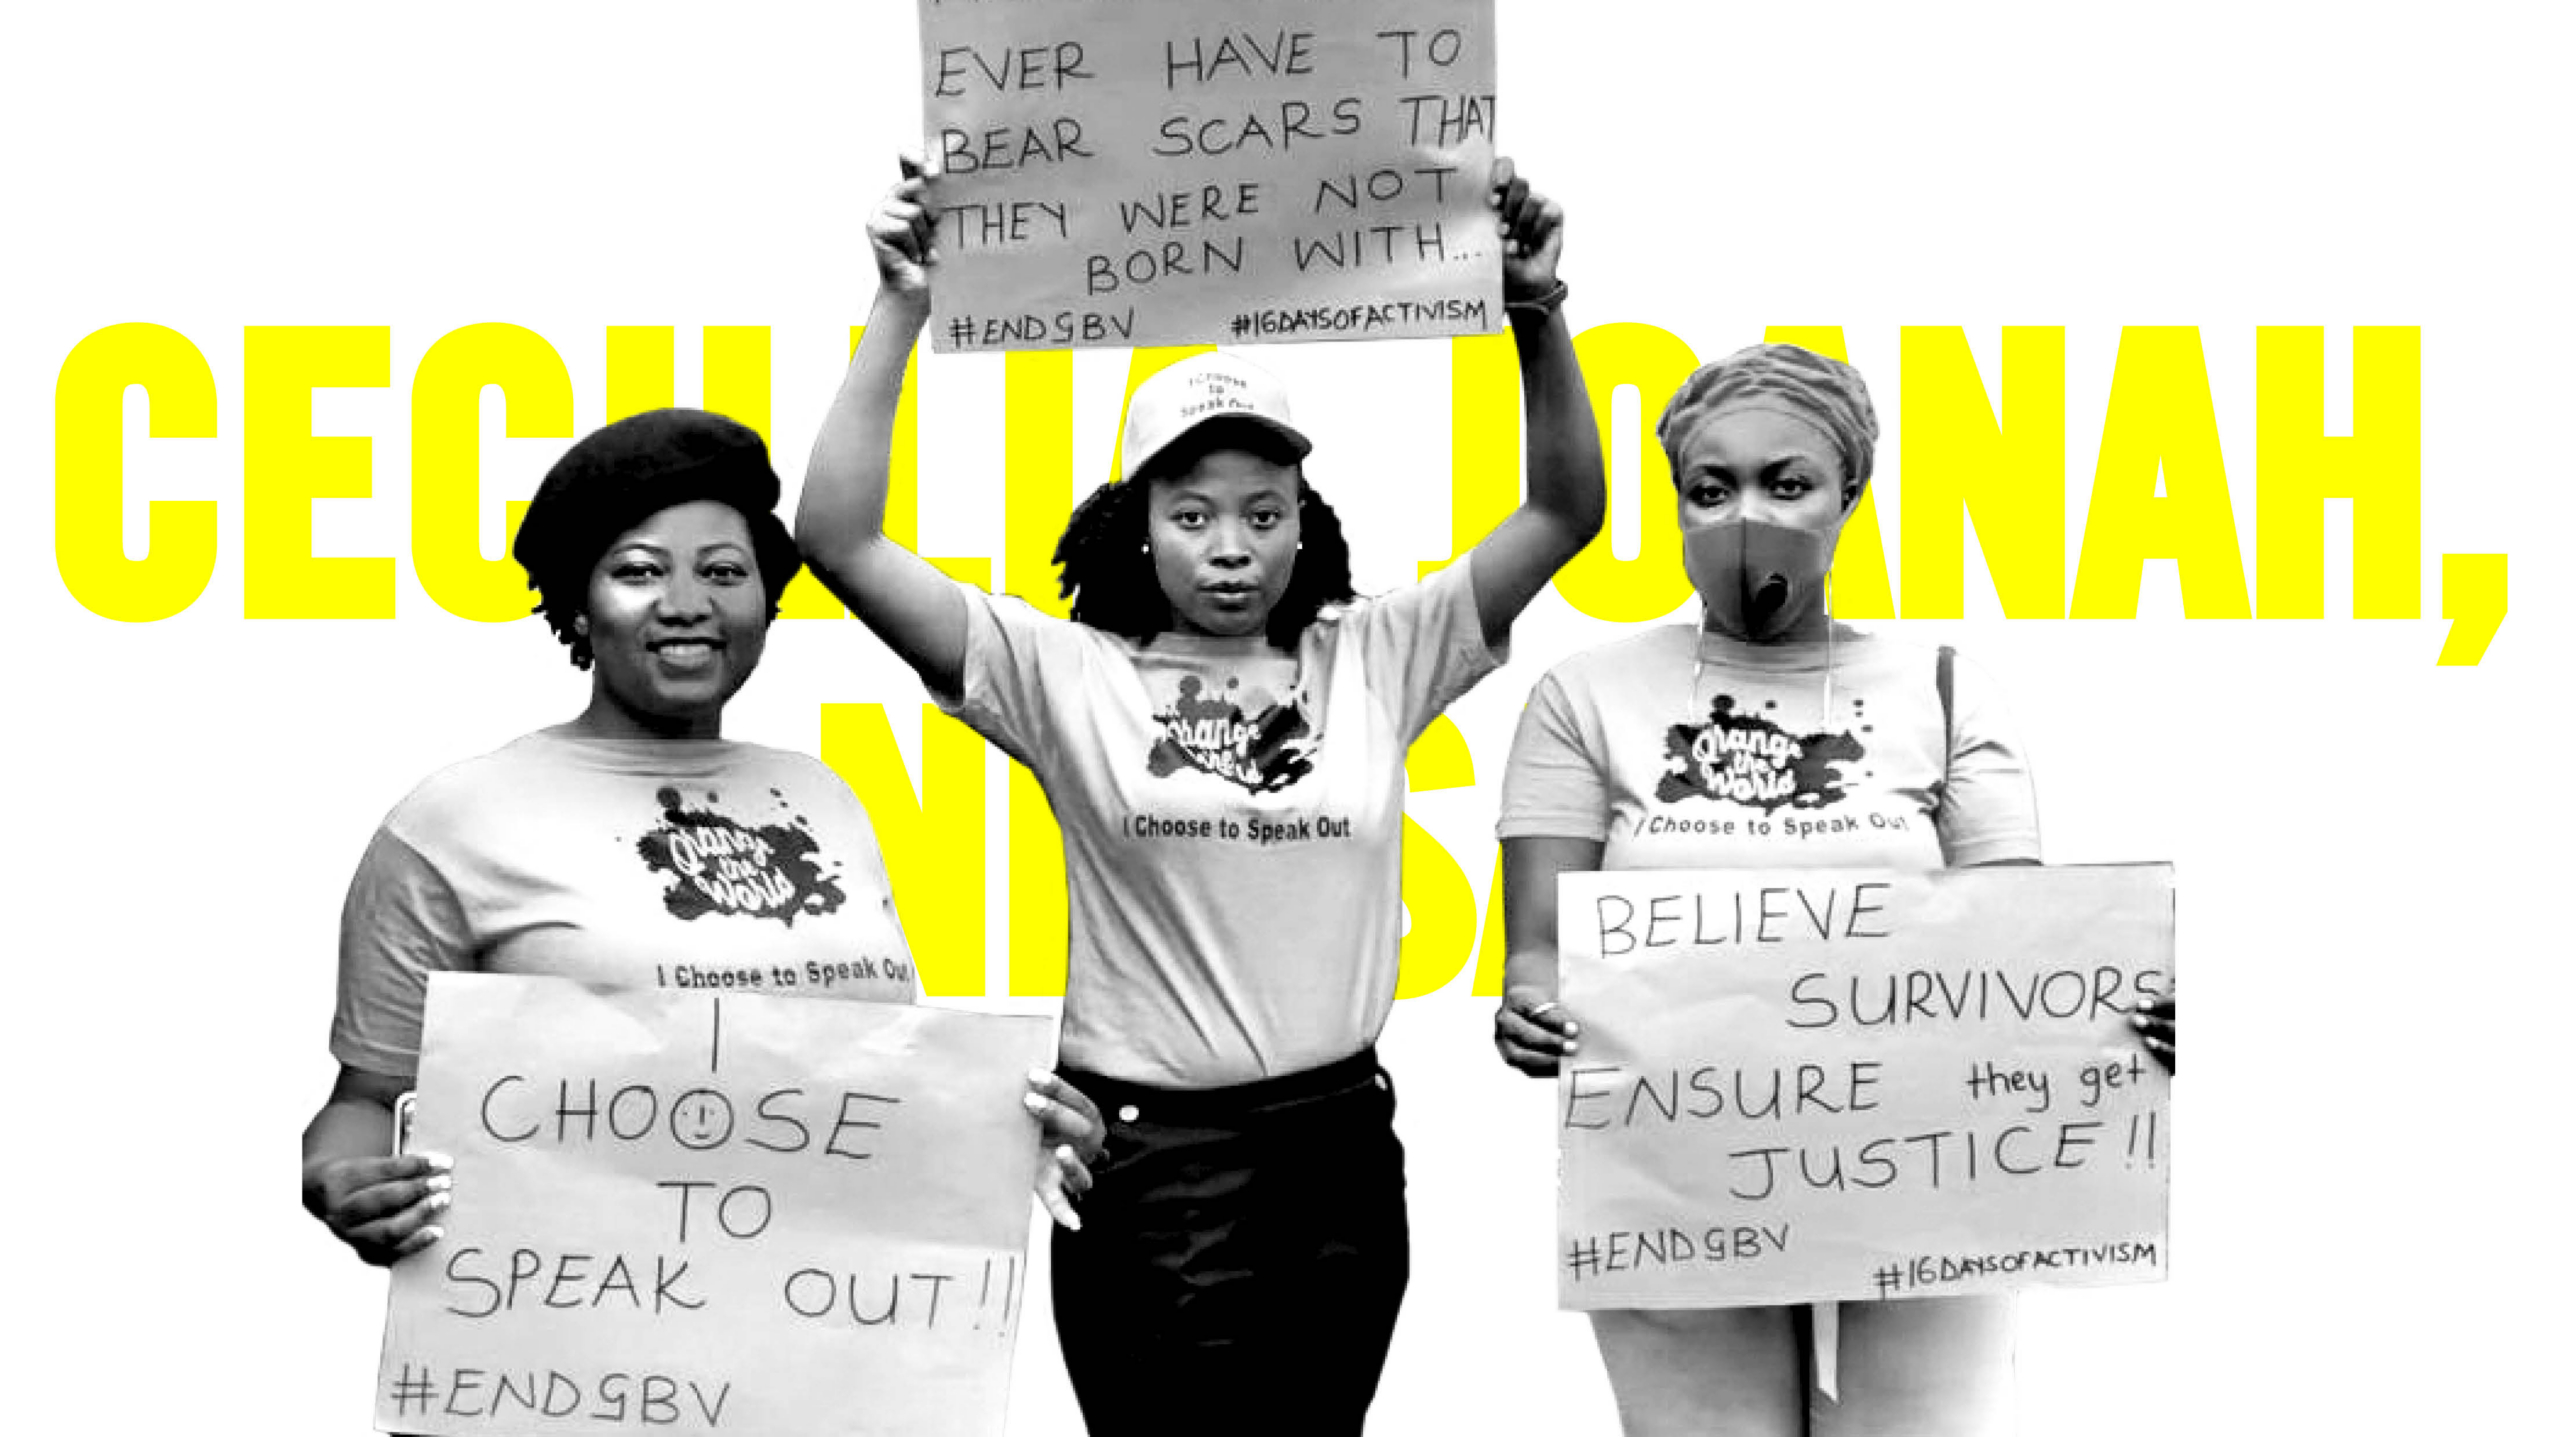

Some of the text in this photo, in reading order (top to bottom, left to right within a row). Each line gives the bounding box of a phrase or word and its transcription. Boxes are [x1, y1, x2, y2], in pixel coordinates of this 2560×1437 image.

[933, 28, 1462, 99] EVER HAVE TO
[940, 94, 1496, 175] BEAR SCARS THAT
[939, 166, 1459, 250] THEY WERE NOT
[1086, 236, 1244, 297] BORN
[1230, 298, 1489, 340] #16DAYSOFACTIVISM
[1135, 814, 1213, 838] Choose
[1218, 816, 1240, 840] to
[1247, 815, 1311, 847] Speak
[1316, 814, 1352, 839] Out
[1648, 814, 1735, 836] Choose
[1747, 819, 1772, 836] to
[1782, 814, 1860, 840] Speak
[1596, 882, 1891, 960] BELIEVE
[674, 963, 764, 989] Choose
[770, 965, 798, 988] to
[804, 955, 879, 989] Speak
[1785, 966, 2163, 1028] SURVIVORS
[479, 1074, 903, 1160] CHOOSE
[1564, 1053, 2147, 1131] ENSURE they get
[655, 1180, 772, 1245] TO
[445, 1247, 707, 1319] SPEAK
[1872, 1241, 2157, 1294] #16DAYSOFACTIVISM
